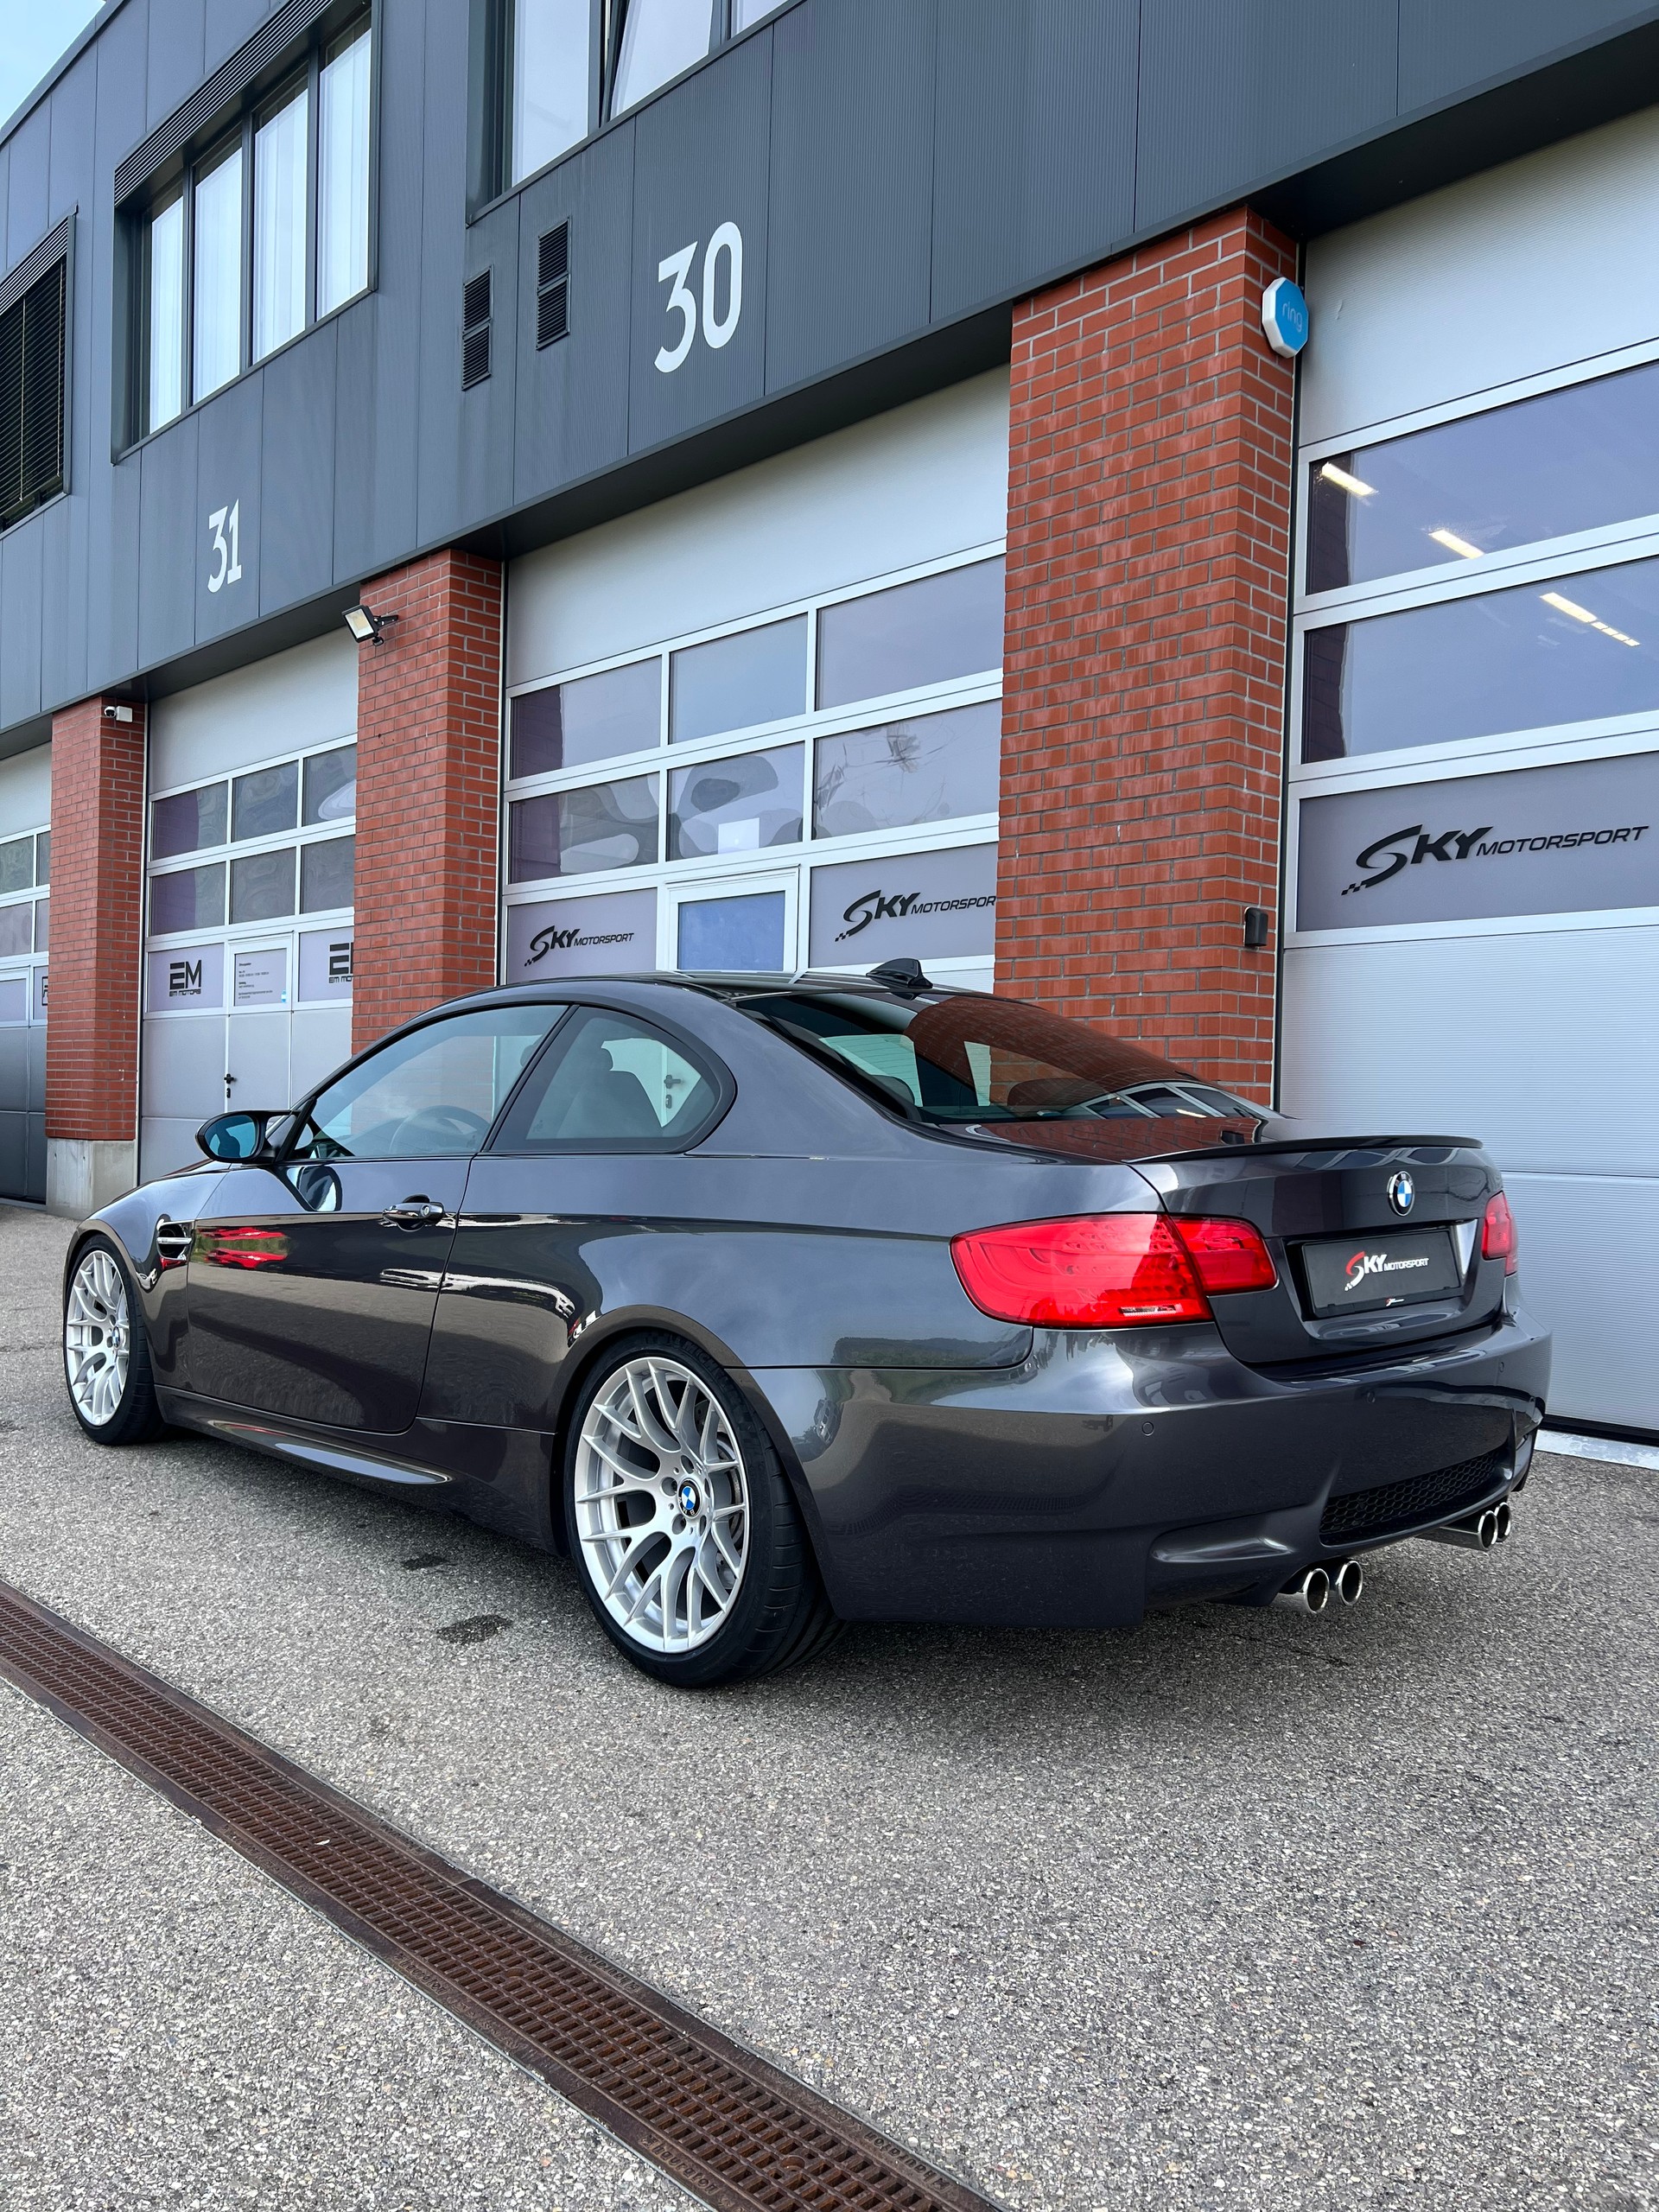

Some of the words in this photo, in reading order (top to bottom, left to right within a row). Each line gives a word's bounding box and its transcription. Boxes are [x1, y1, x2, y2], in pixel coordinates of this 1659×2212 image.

[654, 221, 742, 373] 30
[1282, 302, 1302, 333] ring
[207, 499, 242, 593] 31
[1341, 824, 1493, 896] SKY
[1476, 826, 1649, 856] MOTORSPORT
[835, 890, 920, 942] SKY
[911, 895, 996, 914] MOTORSPOR
[524, 925, 581, 966] SKY
[574, 933, 634, 946] MOTORSPORT
[169, 960, 201, 989] EM
[1344, 1251, 1388, 1291] SKY
[1383, 1258, 1429, 1271] MOTORSPORT
[652, 2143, 720, 2195] hauraton
